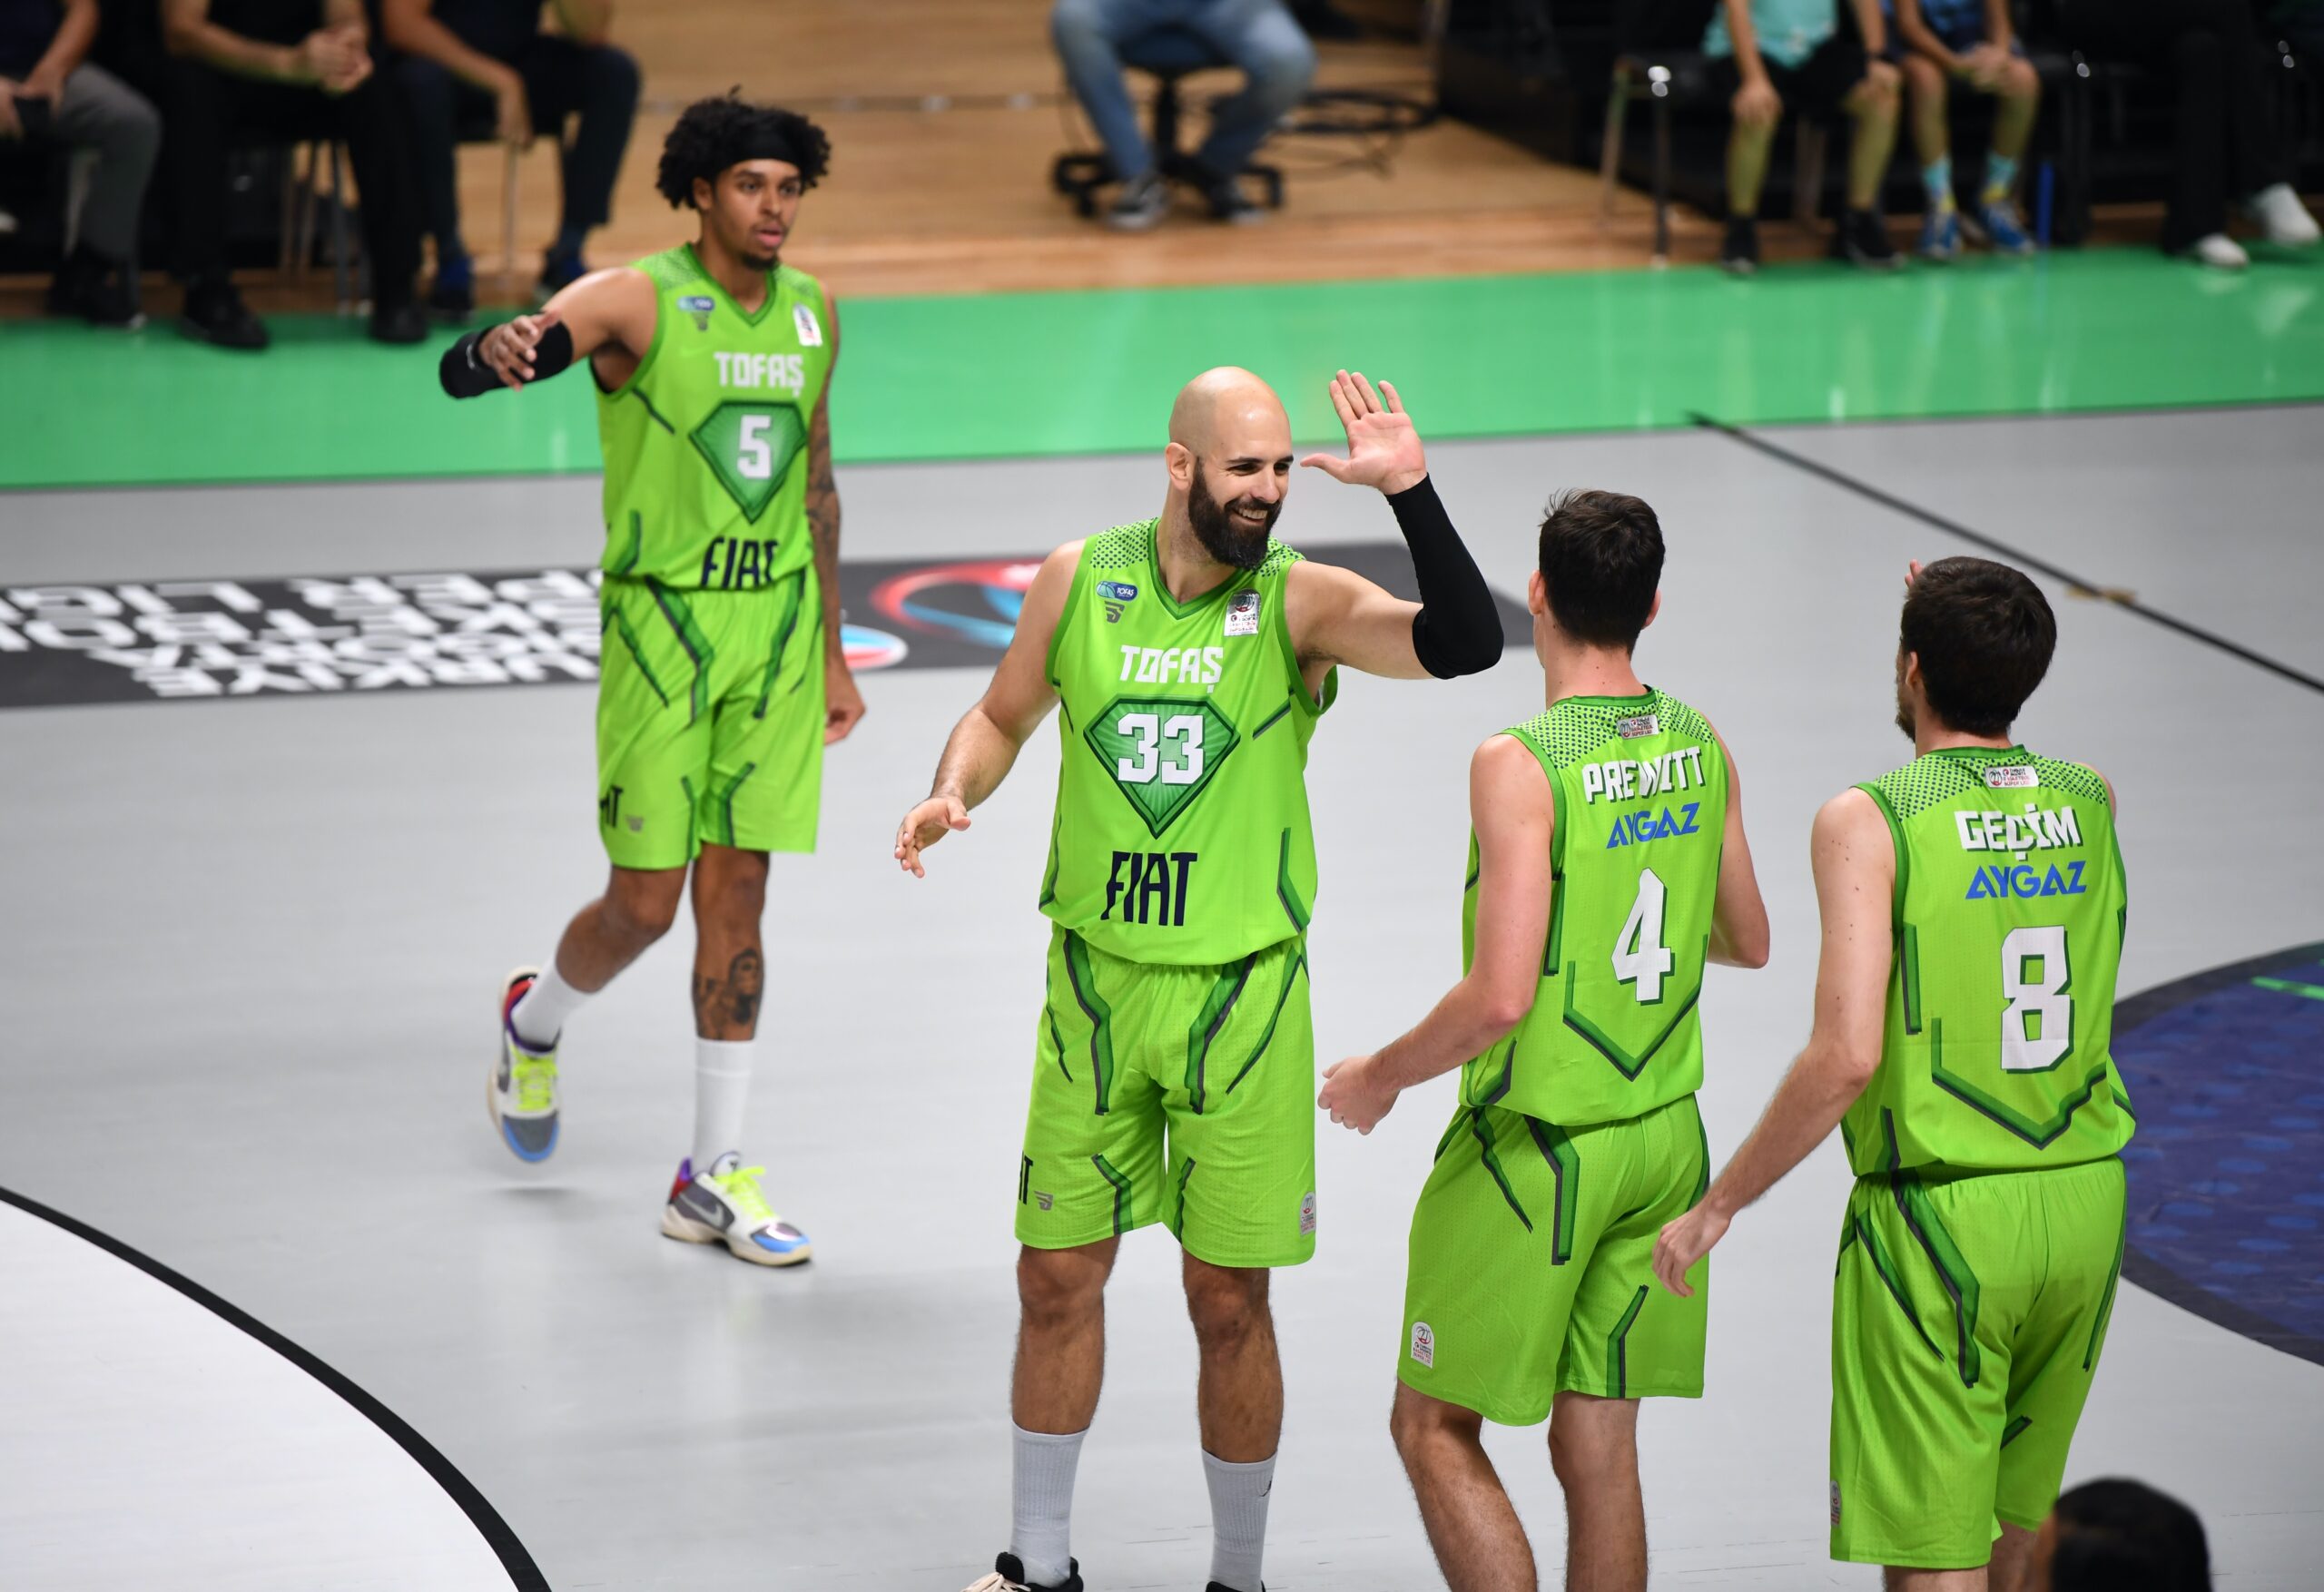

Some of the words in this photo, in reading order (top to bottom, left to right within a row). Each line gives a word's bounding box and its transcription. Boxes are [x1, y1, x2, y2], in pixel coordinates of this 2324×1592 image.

[714, 351, 804, 398] TOFAŞ
[737, 415, 772, 480] 5
[700, 536, 781, 591] FIAT
[1118, 644, 1224, 693] TOFAŞ
[1117, 712, 1206, 786] 33
[1581, 746, 1707, 804] PREWITT
[1606, 802, 1700, 849] AYGAZ
[1954, 802, 2083, 861] GEÇİM
[1100, 850, 1198, 926] FIAT
[1965, 860, 2087, 899] AYGAZ
[1611, 867, 1675, 1006] 4
[2000, 925, 2074, 1074] 8
